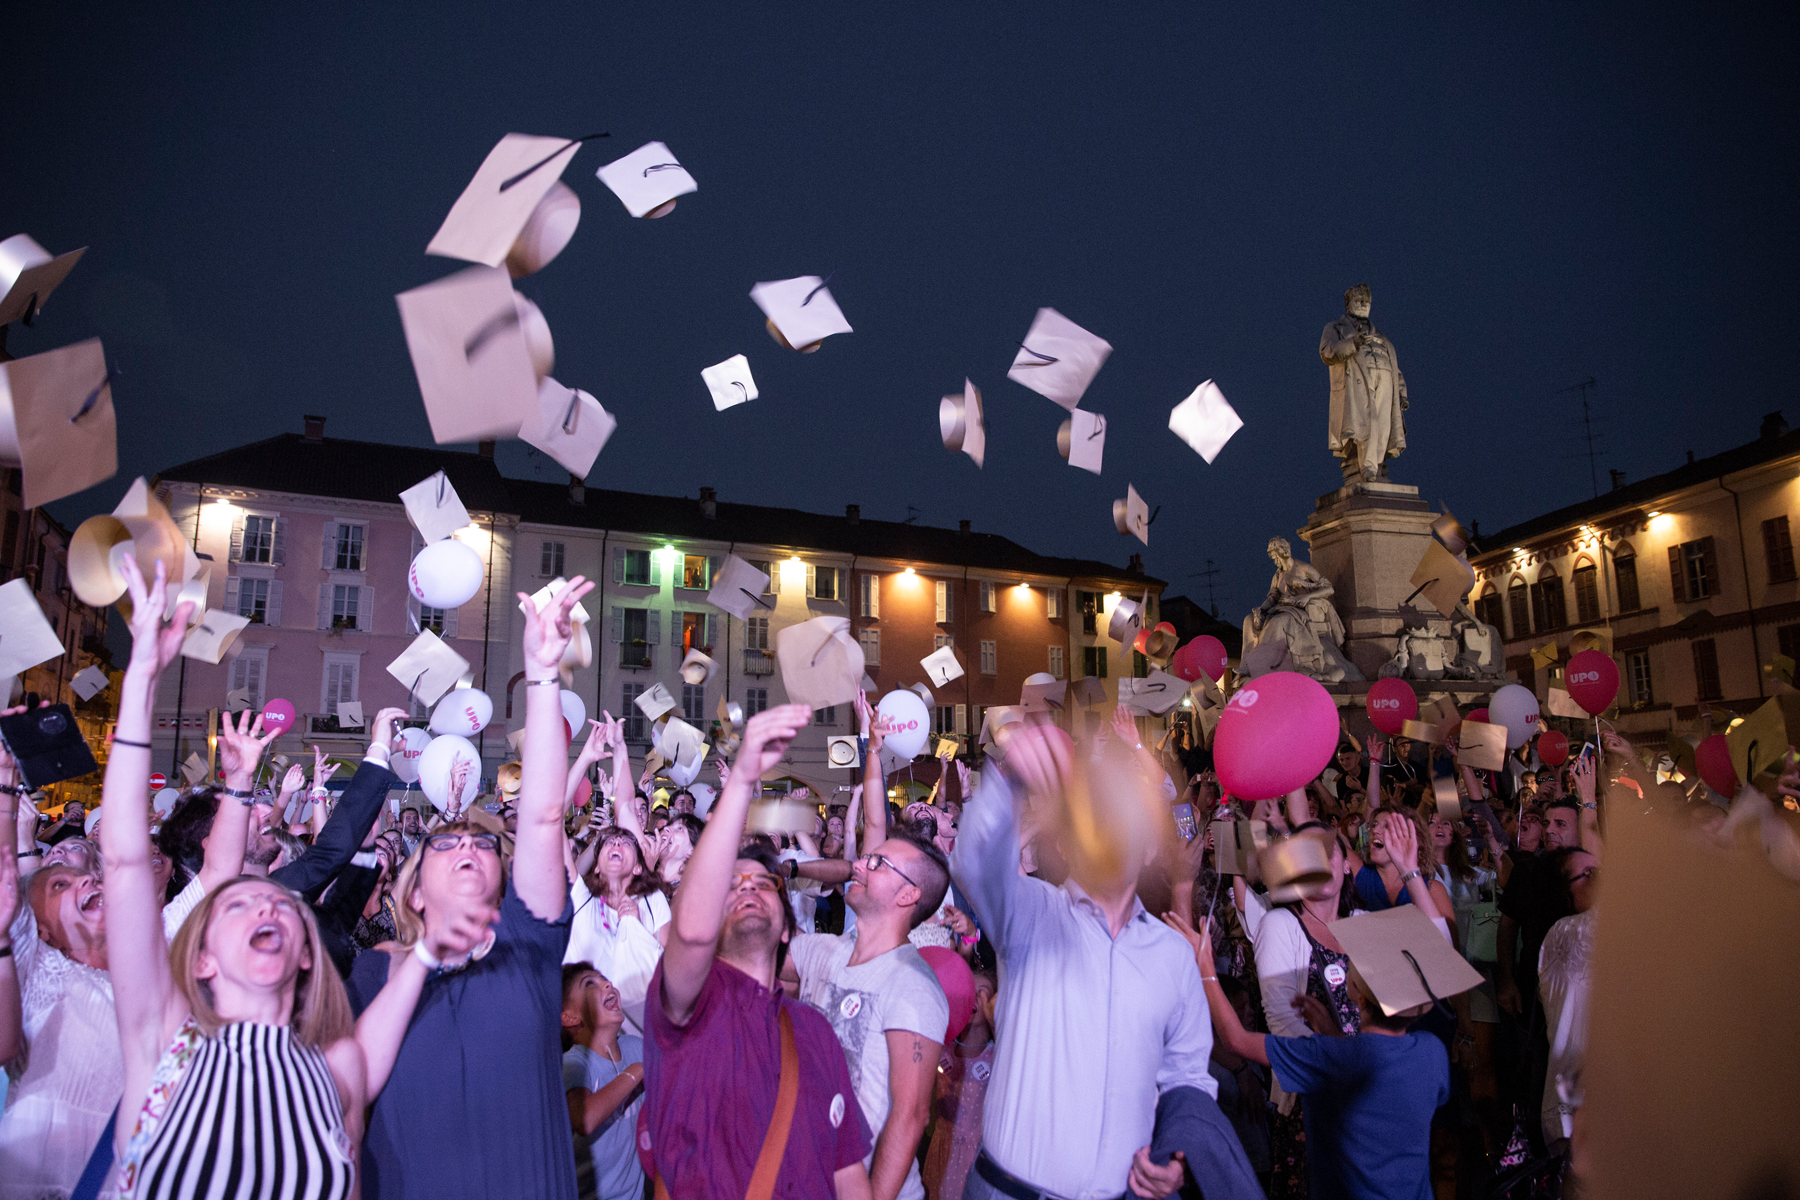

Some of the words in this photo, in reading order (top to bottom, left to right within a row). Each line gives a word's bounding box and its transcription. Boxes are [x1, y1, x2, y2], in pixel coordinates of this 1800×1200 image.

[411, 563, 424, 598] UPO
[1570, 671, 1599, 683] UPO
[1228, 690, 1258, 707] PO
[1373, 699, 1400, 709] UPO
[266, 712, 285, 721] UPO
[465, 706, 480, 731] UPO
[1525, 714, 1539, 724] UP
[403, 750, 423, 759] UP
